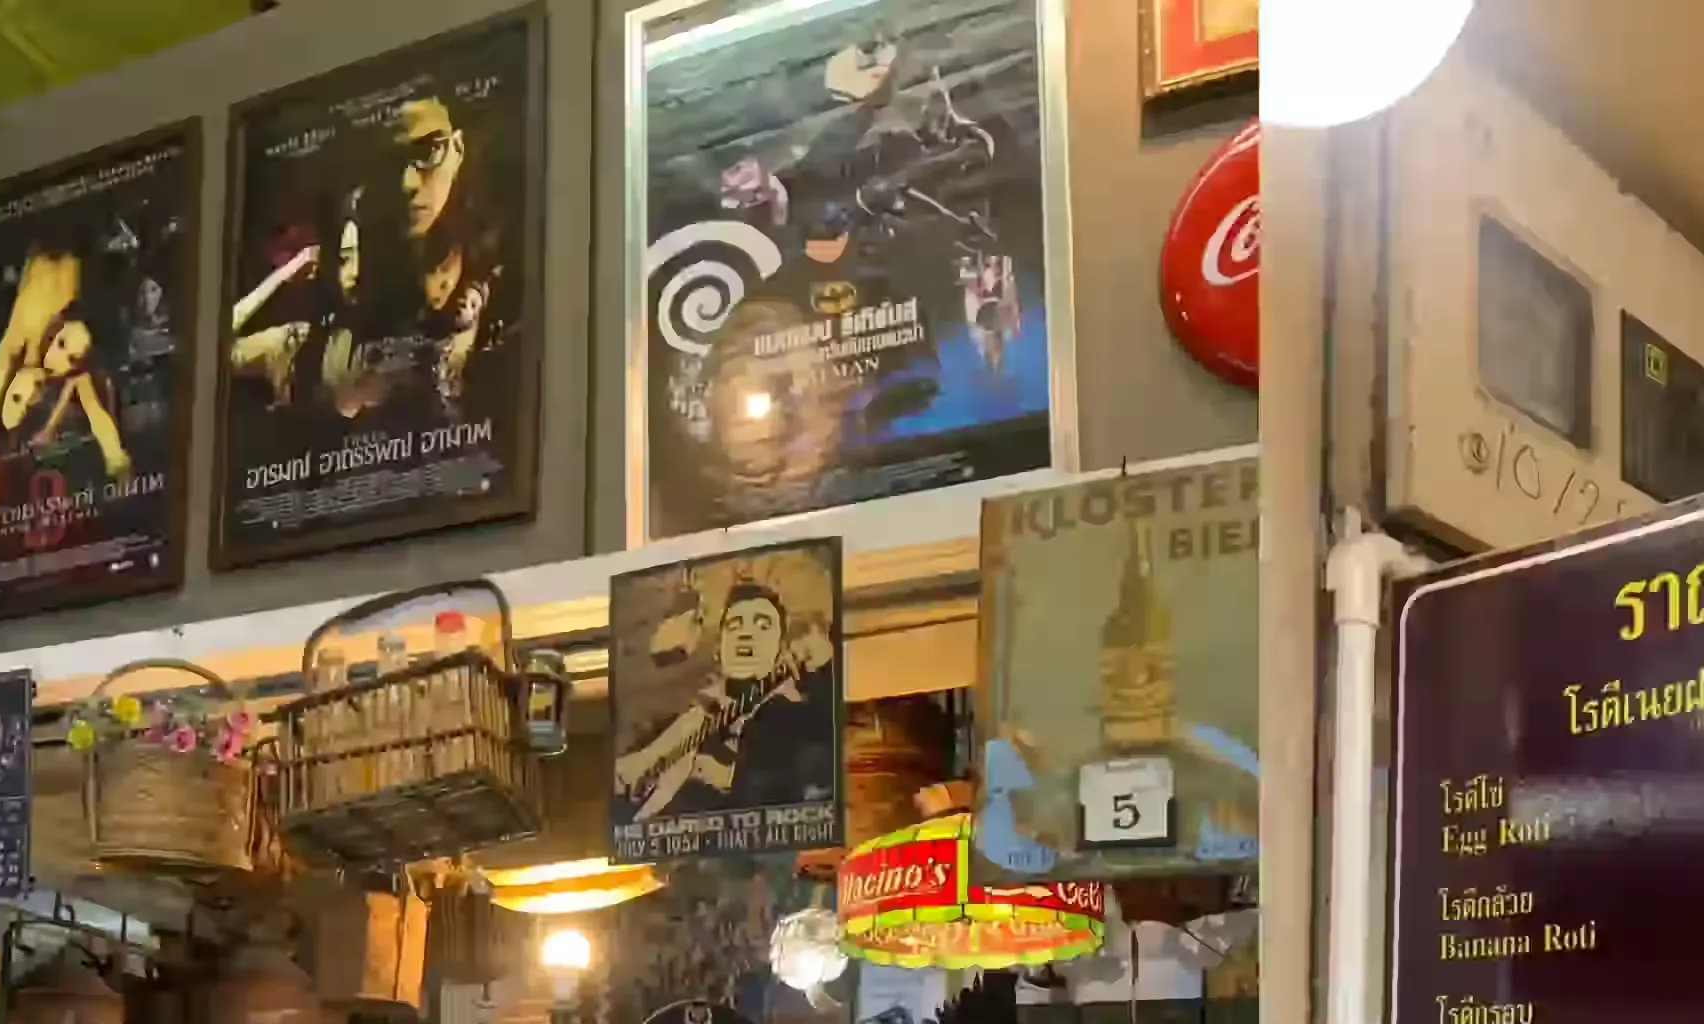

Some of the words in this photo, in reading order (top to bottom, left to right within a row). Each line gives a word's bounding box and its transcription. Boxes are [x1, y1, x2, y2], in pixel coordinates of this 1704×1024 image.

[730, 812, 760, 828] TO
[766, 804, 835, 825] ROCK
[1112, 793, 1141, 829] 5
[1442, 825, 1487, 857] Egg
[1499, 814, 1551, 846] Roti
[1438, 884, 1533, 921] โรตีกล้วย
[1440, 933, 1531, 960] Banana
[1544, 920, 1596, 952] Roti
